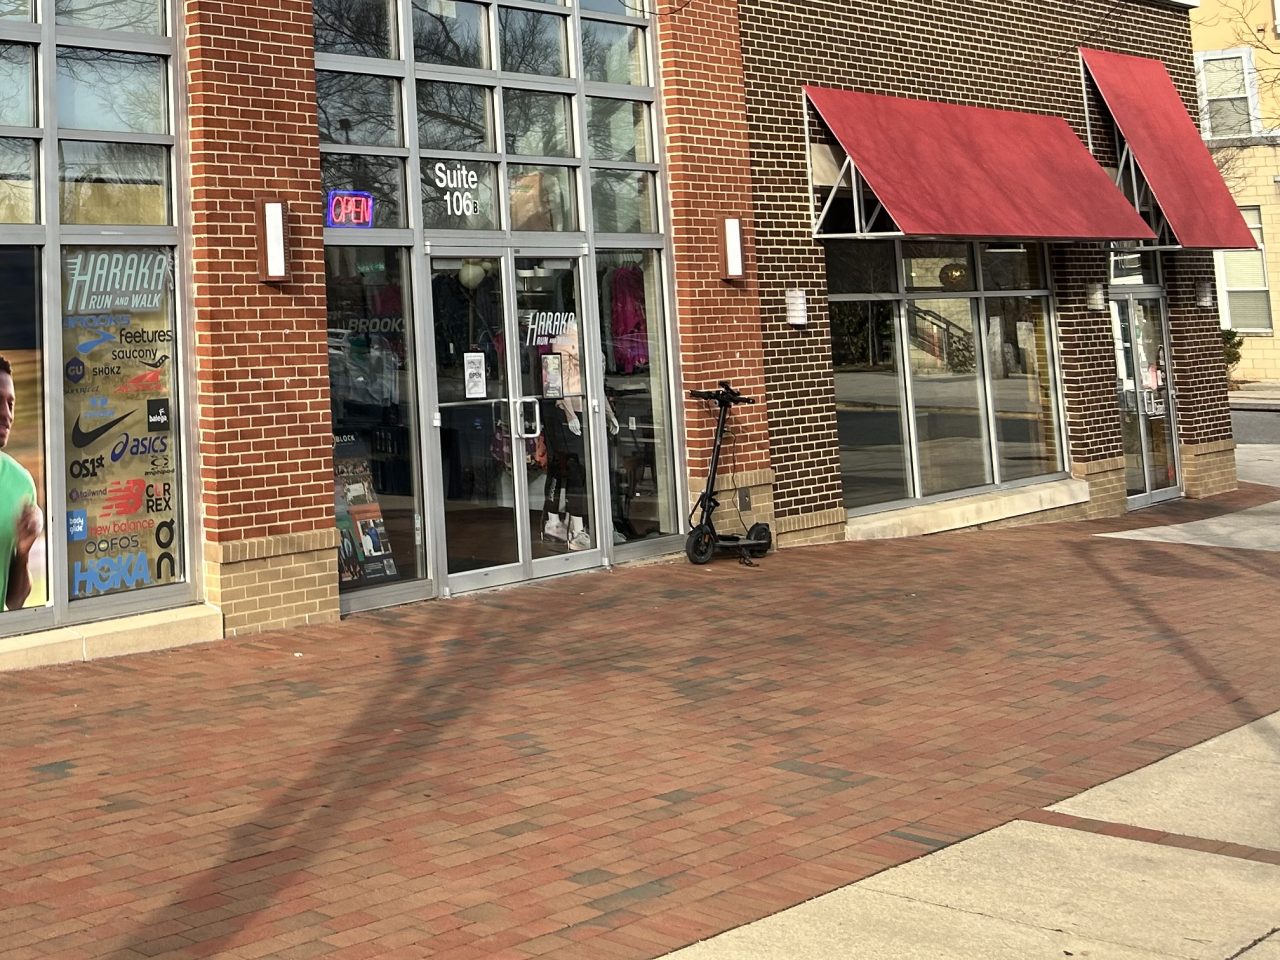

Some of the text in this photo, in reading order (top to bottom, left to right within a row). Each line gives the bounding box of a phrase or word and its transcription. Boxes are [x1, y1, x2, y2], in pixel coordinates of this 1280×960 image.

[434, 162, 478, 189] Suite
[331, 196, 372, 223] OPEN
[66, 253, 167, 311] HARAKA
[88, 293, 161, 310] RUN AND WALK
[119, 327, 174, 345] feetures
[111, 348, 158, 361] saucony
[67, 366, 83, 375] GU
[146, 496, 172, 513] REX
[90, 518, 155, 537] new balance
[85, 534, 140, 554] OOFOS
[74, 551, 151, 595] HOKA
